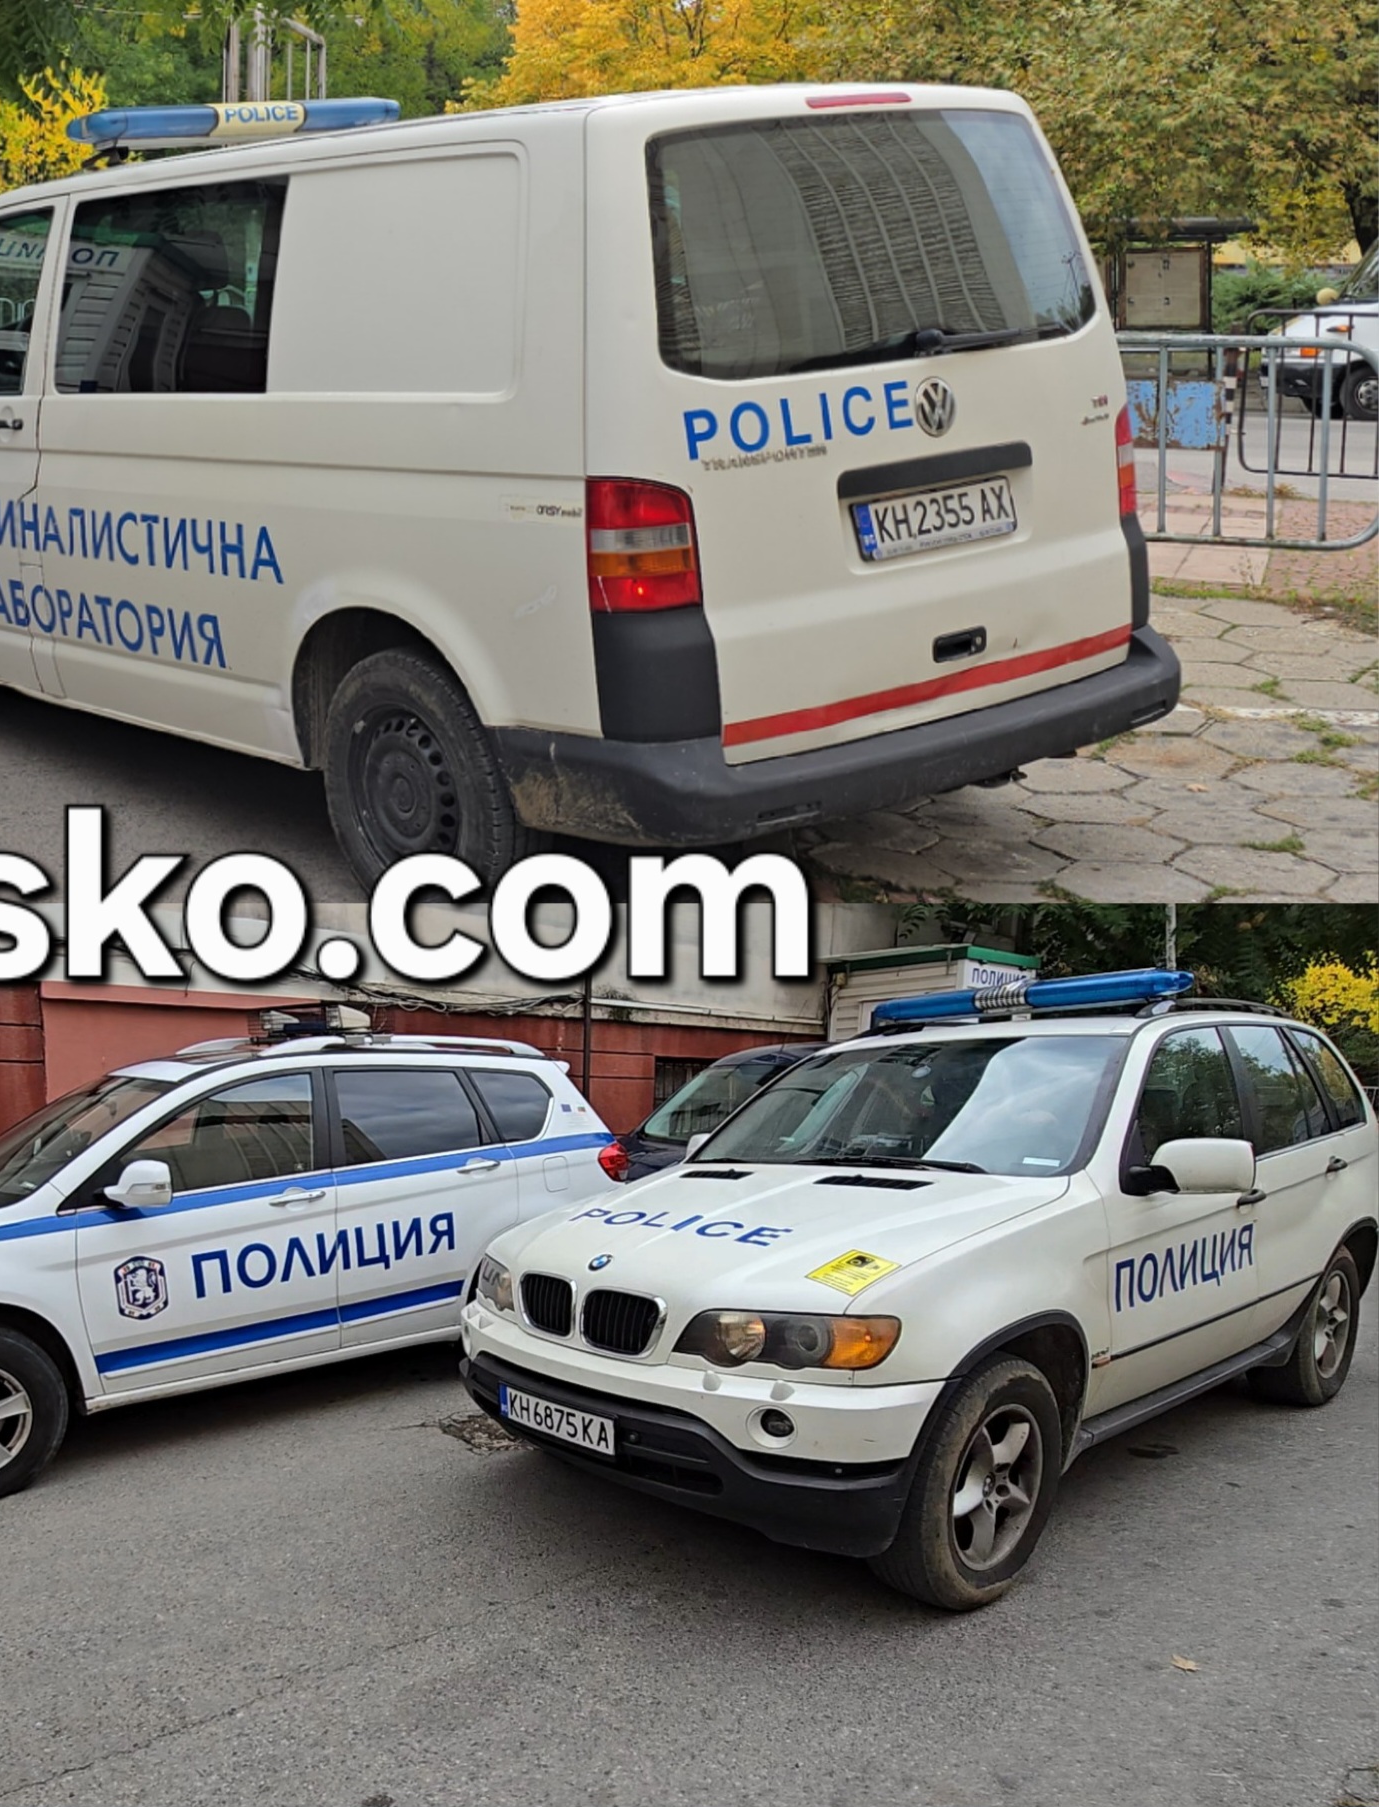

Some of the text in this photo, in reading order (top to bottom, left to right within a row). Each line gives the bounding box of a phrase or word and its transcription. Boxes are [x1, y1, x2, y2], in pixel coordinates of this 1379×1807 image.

[225, 105, 299, 124] POLICE
[683, 380, 914, 461] POLICE
[191, 1211, 456, 1299] ПОЛИЦИЯ
[569, 1208, 793, 1247] POLICE
[1115, 1222, 1254, 1313] ПОЛИЦИЯ
